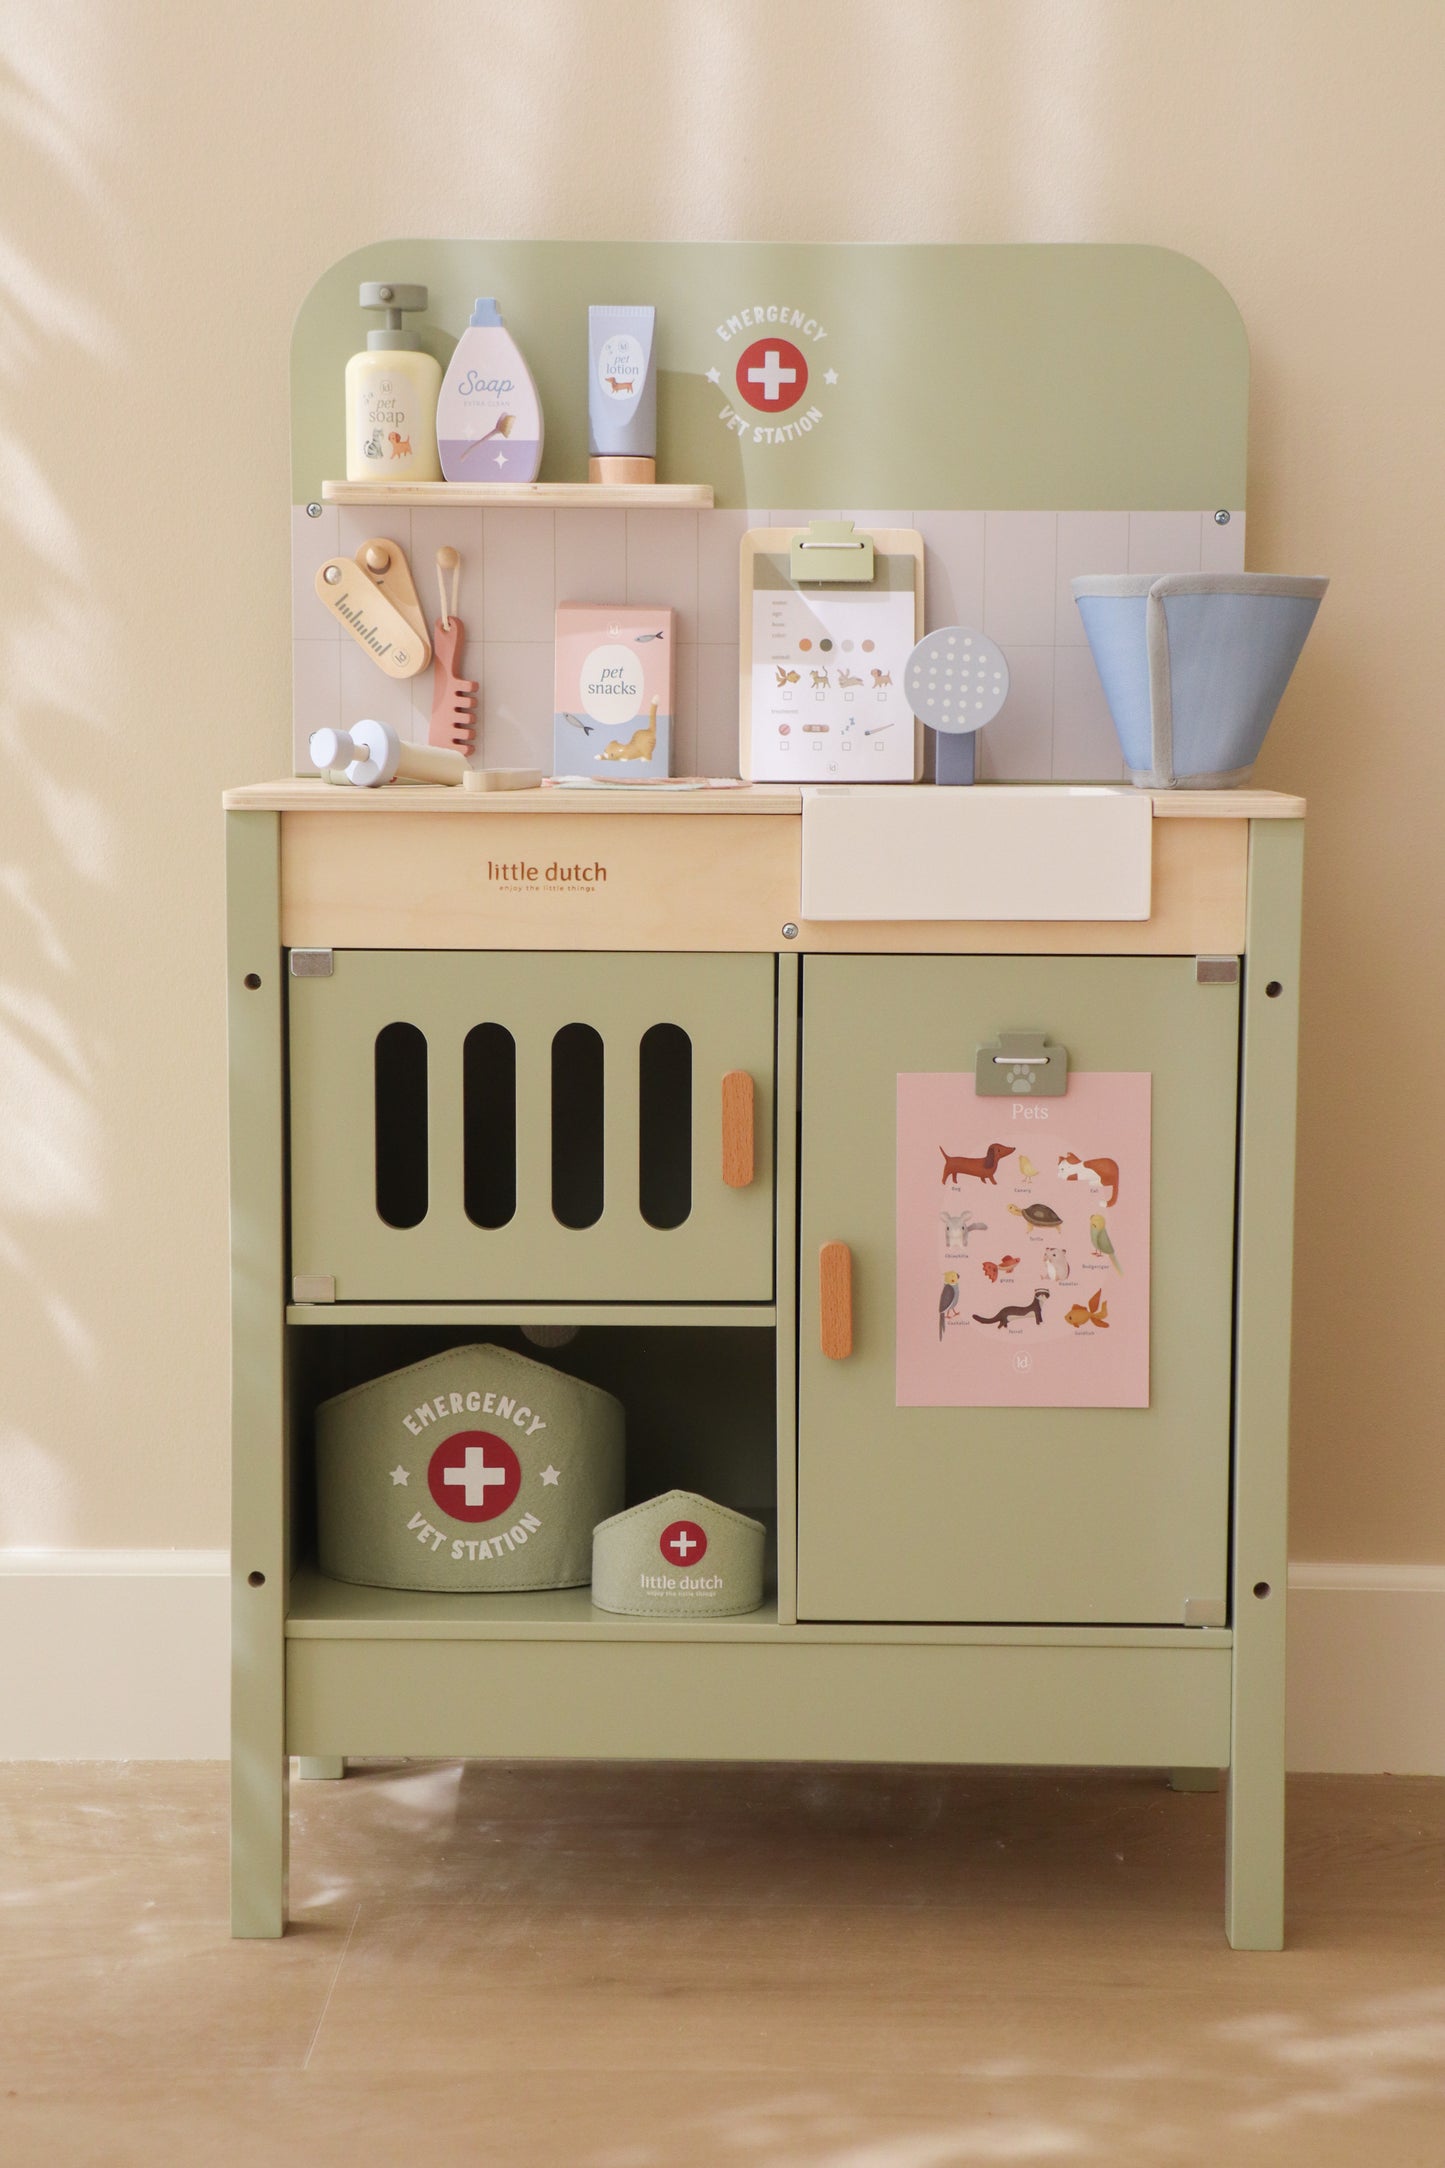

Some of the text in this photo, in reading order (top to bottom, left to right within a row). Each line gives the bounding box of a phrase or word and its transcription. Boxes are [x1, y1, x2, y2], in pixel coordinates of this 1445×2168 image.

[715, 305, 828, 342] EMERGENCY
[606, 363, 639, 374] lotion
[458, 370, 515, 399] Soap
[376, 398, 395, 412] pet
[369, 411, 405, 428] soap
[718, 404, 824, 444] VET STATION
[600, 666, 624, 682] pet
[588, 681, 637, 695] snacks
[488, 861, 607, 882] little dutch
[1011, 1103, 1049, 1120] Pets
[402, 1391, 546, 1436] EMERGENCY
[406, 1511, 542, 1561] VET STATION
[640, 1574, 723, 1590] little dutch
